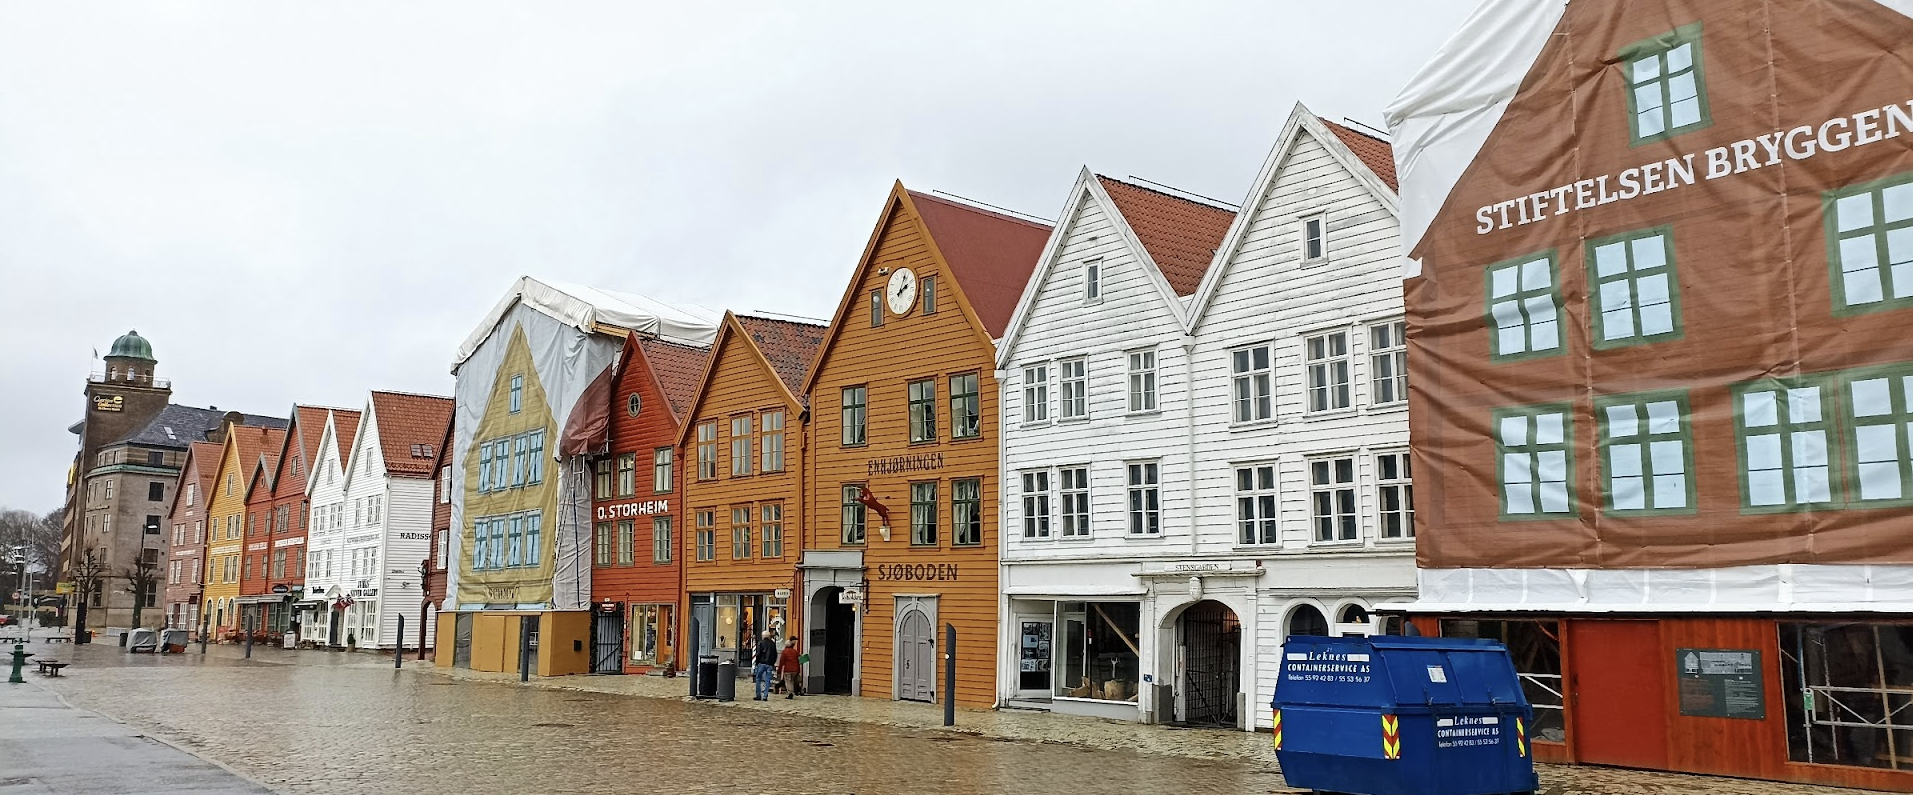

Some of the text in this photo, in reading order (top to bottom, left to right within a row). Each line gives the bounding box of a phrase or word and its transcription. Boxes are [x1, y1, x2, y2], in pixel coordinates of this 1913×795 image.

[1476, 99, 1913, 235] STIFTELSEN BRYGGEN
[597, 500, 668, 520] O. STORHEIM
[400, 532, 431, 540] RADISS
[878, 564, 958, 580] SJØBODEN
[1308, 652, 1346, 661] Leknes
[1288, 664, 1370, 673] CONTAINERSERVICE AS
[1454, 716, 1482, 726] Leknes
[1438, 728, 1490, 738] CONTAINERSERVICE
